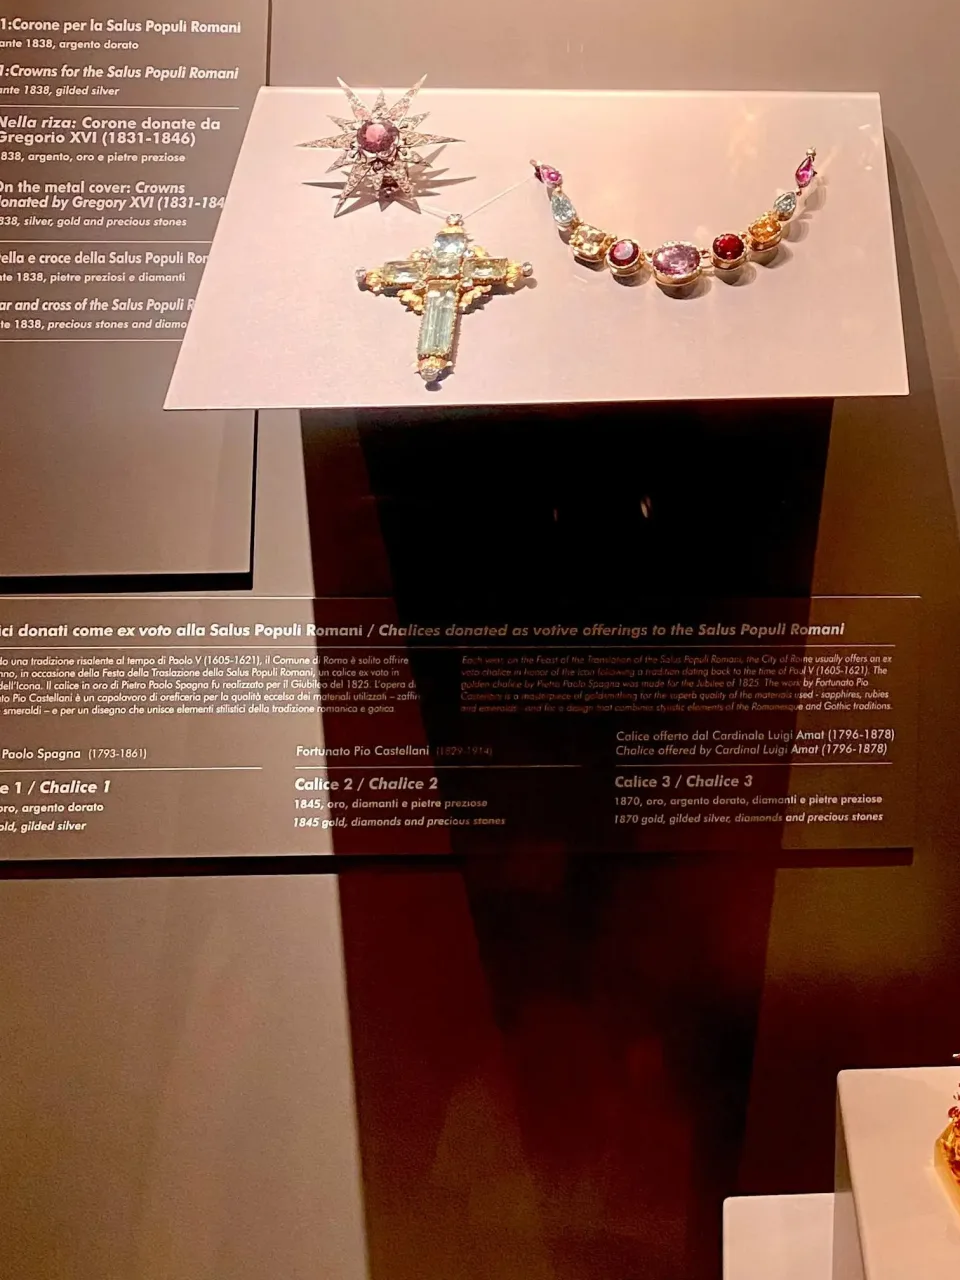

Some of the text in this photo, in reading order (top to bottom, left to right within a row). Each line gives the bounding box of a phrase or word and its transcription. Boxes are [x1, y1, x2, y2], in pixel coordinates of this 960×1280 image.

[63, 21, 87, 33] per
[90, 18, 102, 31] la
[106, 18, 141, 31] Salus
[145, 19, 186, 35] Populi
[190, 20, 241, 33] Romani
[0, 38, 139, 50] ante 1838, argento dorato
[60, 64, 80, 77] for
[82, 65, 103, 77] the
[106, 65, 141, 78] Salus
[144, 65, 186, 81] Populi
[188, 66, 239, 79] Romani
[41, 116, 76, 128] riza:
[81, 116, 136, 129] Corone
[141, 116, 196, 129] donate
[200, 117, 220, 129] da
[69, 131, 96, 143] XVI
[101, 131, 195, 147] (1831-1846)
[18, 623, 67, 636] donati
[72, 626, 113, 636] come
[117, 627, 135, 636] ex
[138, 624, 171, 636] voto
[176, 623, 205, 636] alla
[209, 623, 250, 636] Salus
[254, 623, 301, 639] Populi
[306, 623, 362, 636] Romani
[378, 623, 440, 636] Chalices
[444, 623, 508, 636] donated
[511, 627, 528, 636] as
[533, 624, 578, 635] votive
[582, 623, 647, 638] offerings
[652, 625, 666, 635] to
[670, 623, 693, 635] the
[698, 622, 736, 635] Salus
[740, 622, 786, 638] Populi
[790, 622, 844, 635] Romani
[616, 728, 894, 742] Calice offerto dal Cardinale Luigi Amat (1796-1878)
[1, 747, 146, 761] Paolo Spagna (1793-1861)
[296, 745, 350, 756] Fortunato
[354, 745, 370, 756] Pio
[374, 744, 429, 755] Castellani
[14, 781, 21, 793] 1
[39, 779, 97, 793] Chalice
[104, 780, 110, 793] 1
[294, 777, 339, 790] Calice
[343, 777, 352, 790] 2
[368, 776, 424, 789] Chalice
[428, 776, 437, 789] 2
[614, 775, 657, 787] Calice
[661, 775, 670, 787] 3
[686, 774, 739, 787] Chalice
[743, 774, 752, 786] 3
[294, 799, 324, 810] 1845,
[327, 801, 348, 809] oro,
[351, 798, 398, 808] diamanti
[411, 798, 441, 810] pietre
[444, 800, 487, 809] preziose
